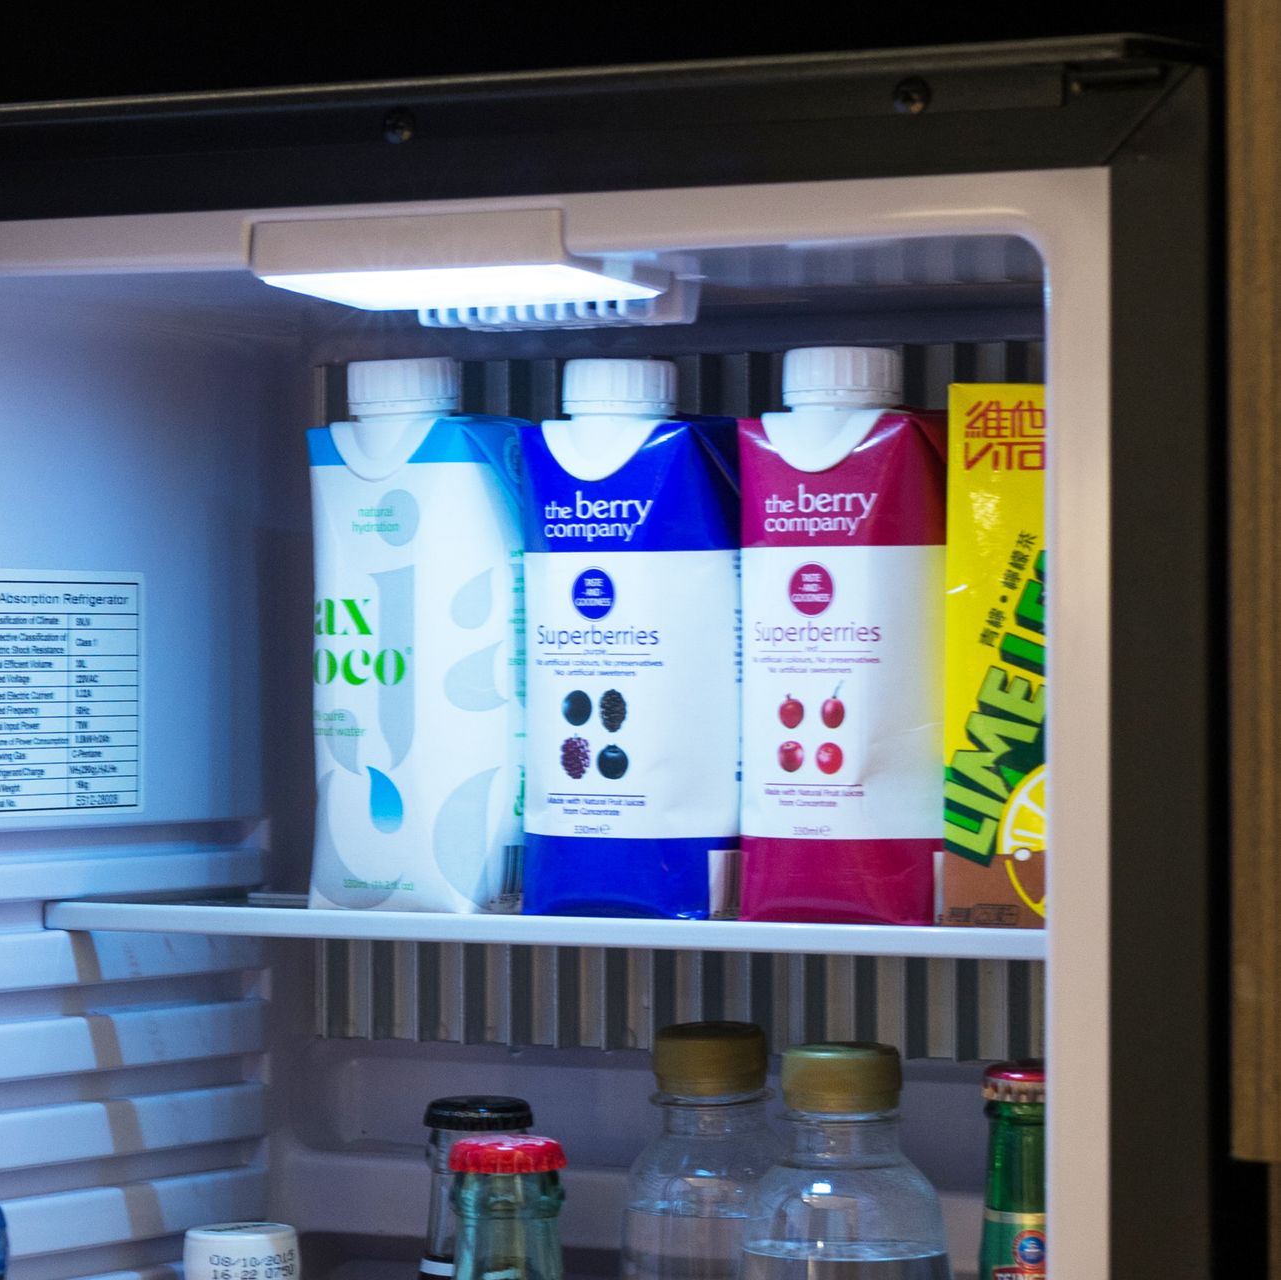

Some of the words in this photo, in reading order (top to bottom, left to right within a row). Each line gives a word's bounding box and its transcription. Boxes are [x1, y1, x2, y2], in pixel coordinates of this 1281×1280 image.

[544, 501, 573, 519] the
[575, 490, 654, 525] berry
[764, 494, 795, 513] the
[798, 483, 878, 519] berry
[359, 507, 394, 517] natural
[352, 521, 399, 535] hydration
[544, 523, 637, 542] company
[764, 517, 859, 536] company
[63, 593, 129, 608] Refrigerator
[537, 625, 659, 650] Superberries
[754, 621, 882, 646] Superberries
[336, 726, 366, 737] water
